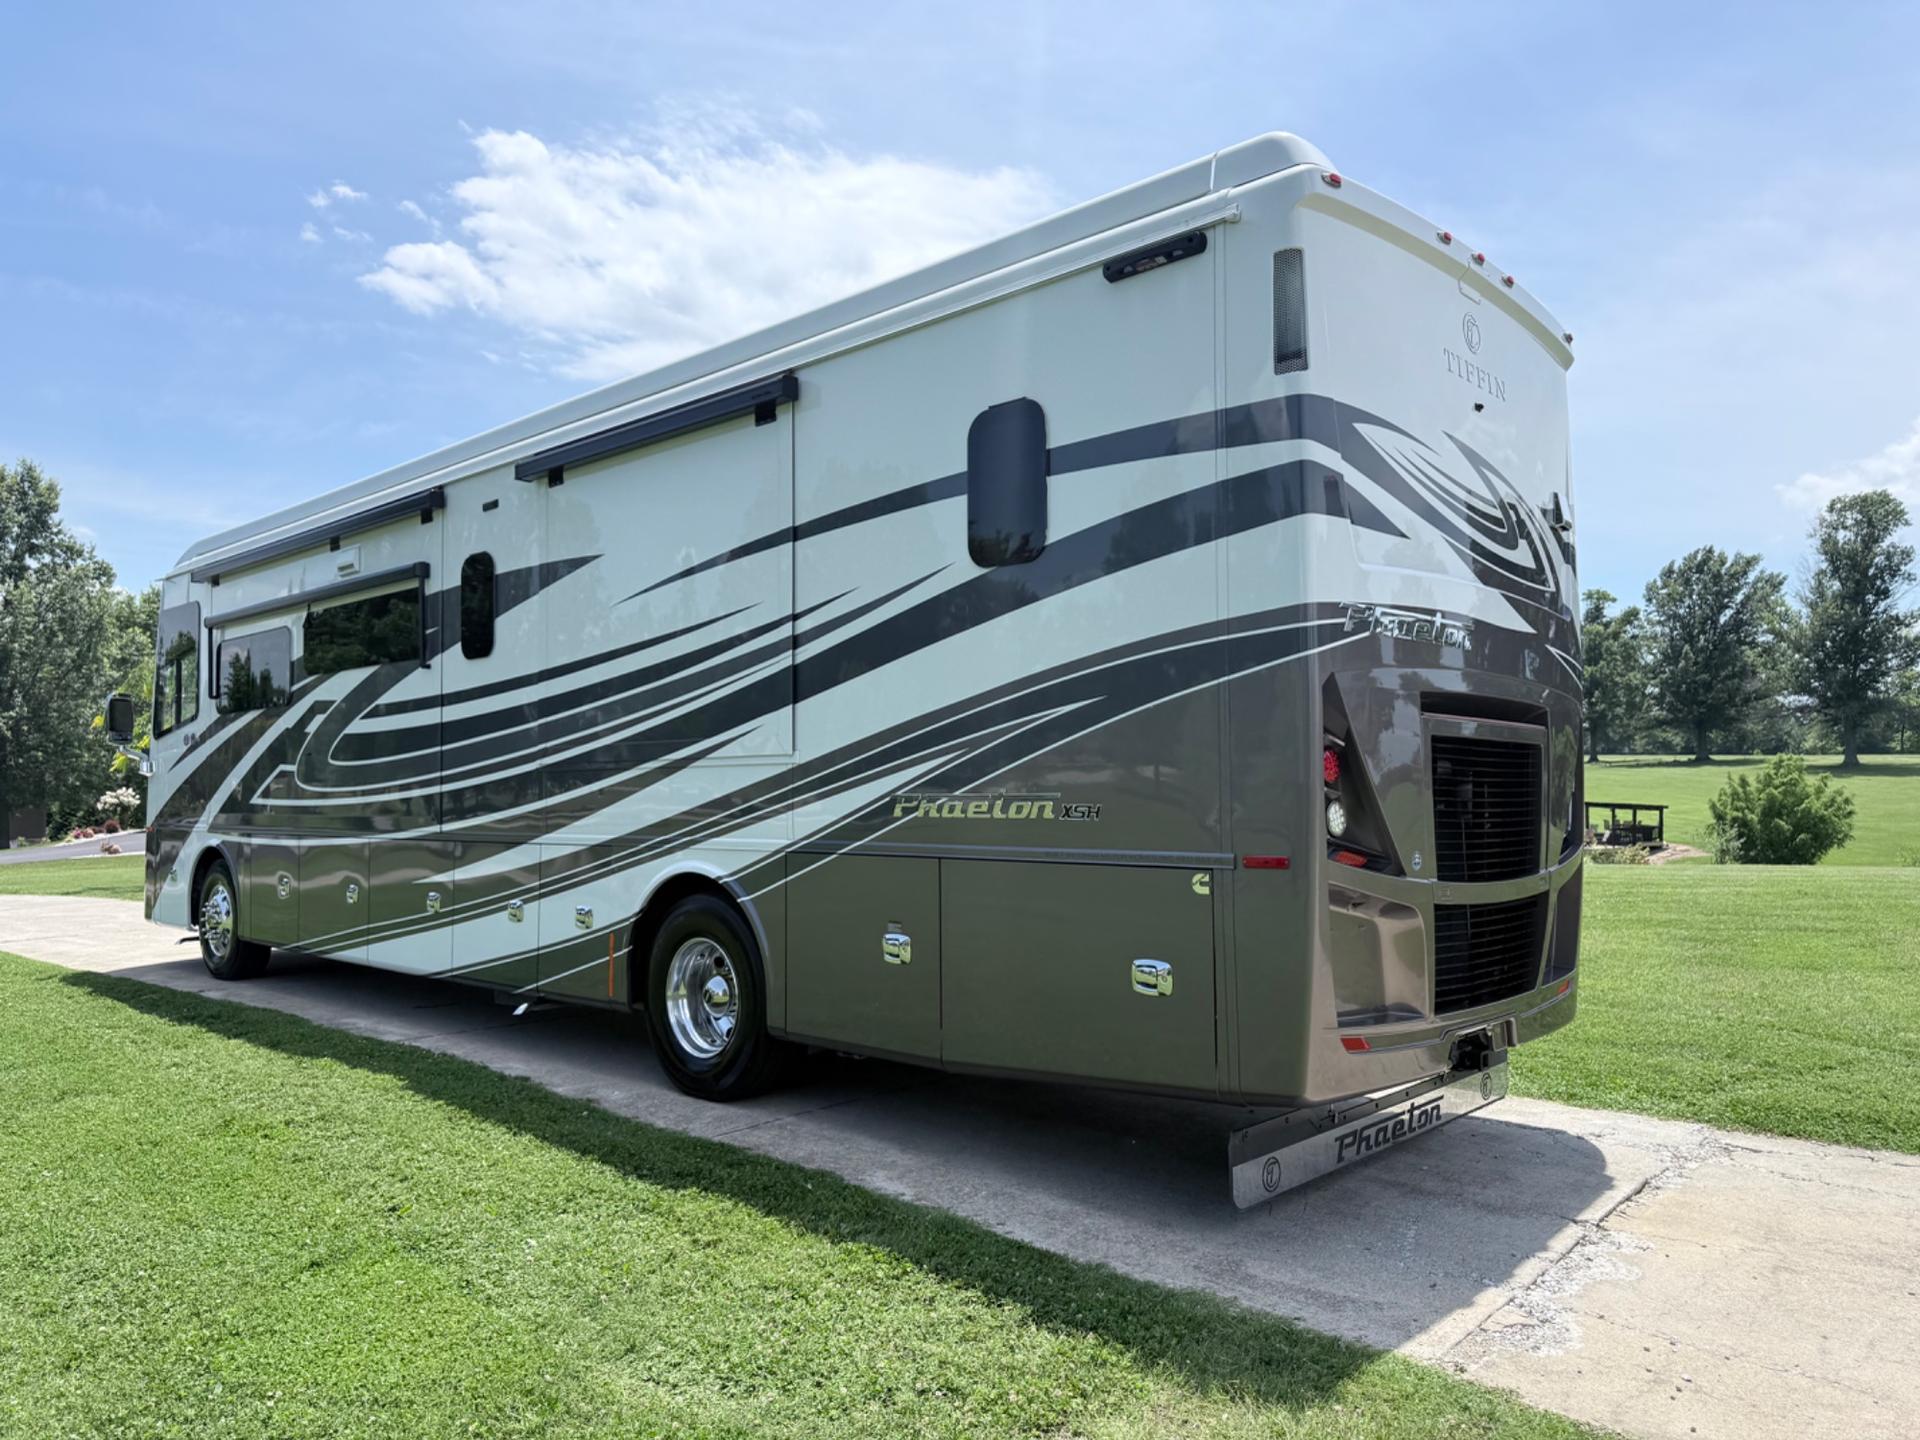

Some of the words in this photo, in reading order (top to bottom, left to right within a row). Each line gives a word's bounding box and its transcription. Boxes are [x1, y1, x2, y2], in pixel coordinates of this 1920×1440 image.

[1443, 347, 1506, 402] TIFFIN
[891, 790, 1060, 819] Phaeton
[1059, 803, 1102, 821] XSH
[1335, 1095, 1444, 1163] Phaeton
